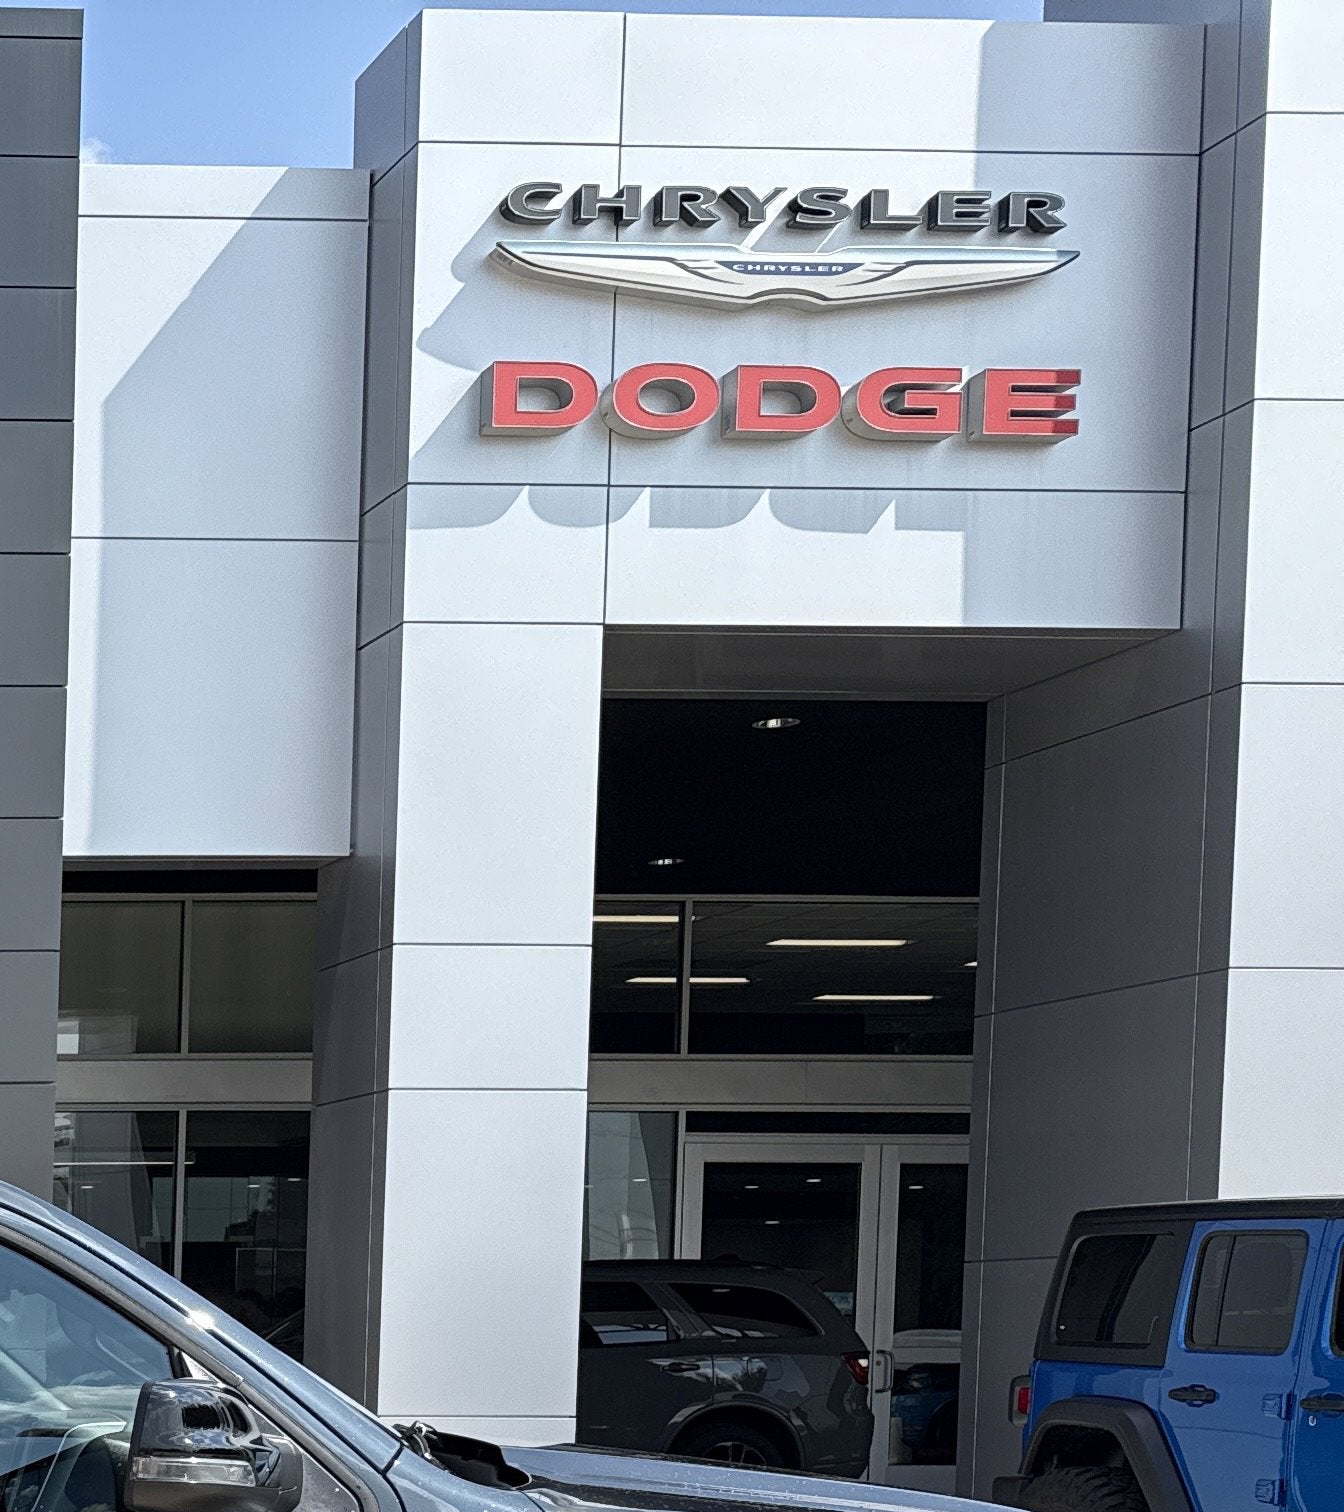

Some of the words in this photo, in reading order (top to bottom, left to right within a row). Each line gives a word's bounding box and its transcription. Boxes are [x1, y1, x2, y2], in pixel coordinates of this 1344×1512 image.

[499, 181, 1067, 234] CHRYSLER
[732, 263, 844, 273] CHRYSLER
[480, 360, 1082, 444] DODGE
